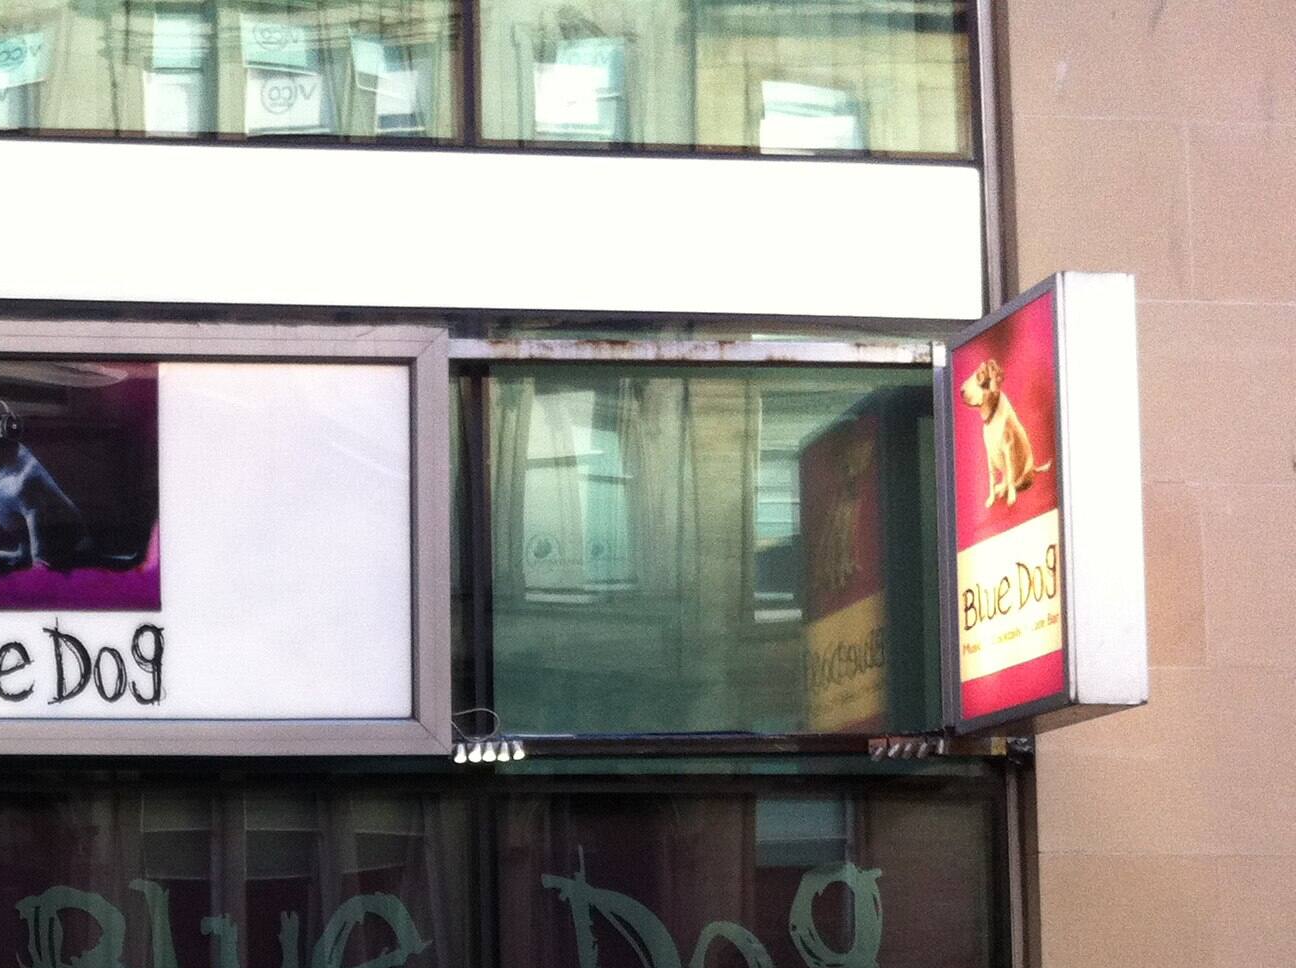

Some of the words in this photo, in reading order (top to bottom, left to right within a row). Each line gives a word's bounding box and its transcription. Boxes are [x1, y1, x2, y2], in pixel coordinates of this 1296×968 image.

[962, 576, 1012, 631] Blue
[1016, 544, 1058, 610] Dog
[42, 617, 166, 705] Dog
